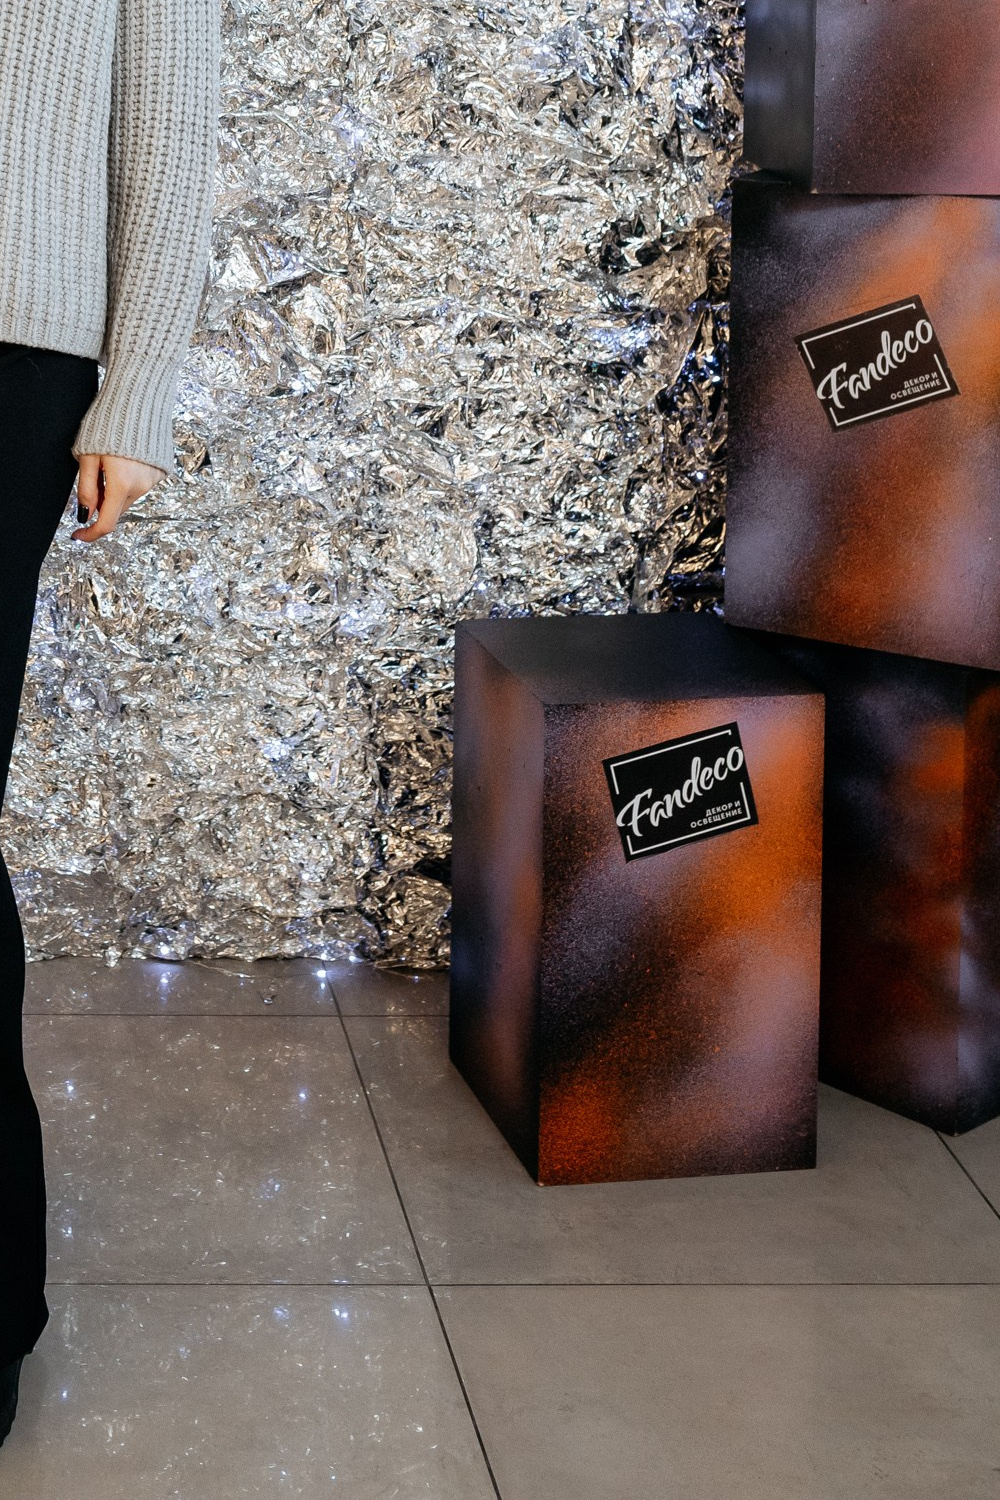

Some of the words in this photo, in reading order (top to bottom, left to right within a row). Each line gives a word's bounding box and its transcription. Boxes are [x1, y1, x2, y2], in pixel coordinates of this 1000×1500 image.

[816, 319, 933, 409] Fandeco
[890, 379, 942, 400] ОСВЕЩЕНИЕ
[903, 373, 931, 389] ДЕКОР
[931, 371, 938, 379] И
[616, 746, 744, 837] Fandeco
[690, 807, 743, 828] ОСВЕЩЕНИЕ
[705, 802, 733, 817] ДЕКОР
[734, 800, 741, 808] И
